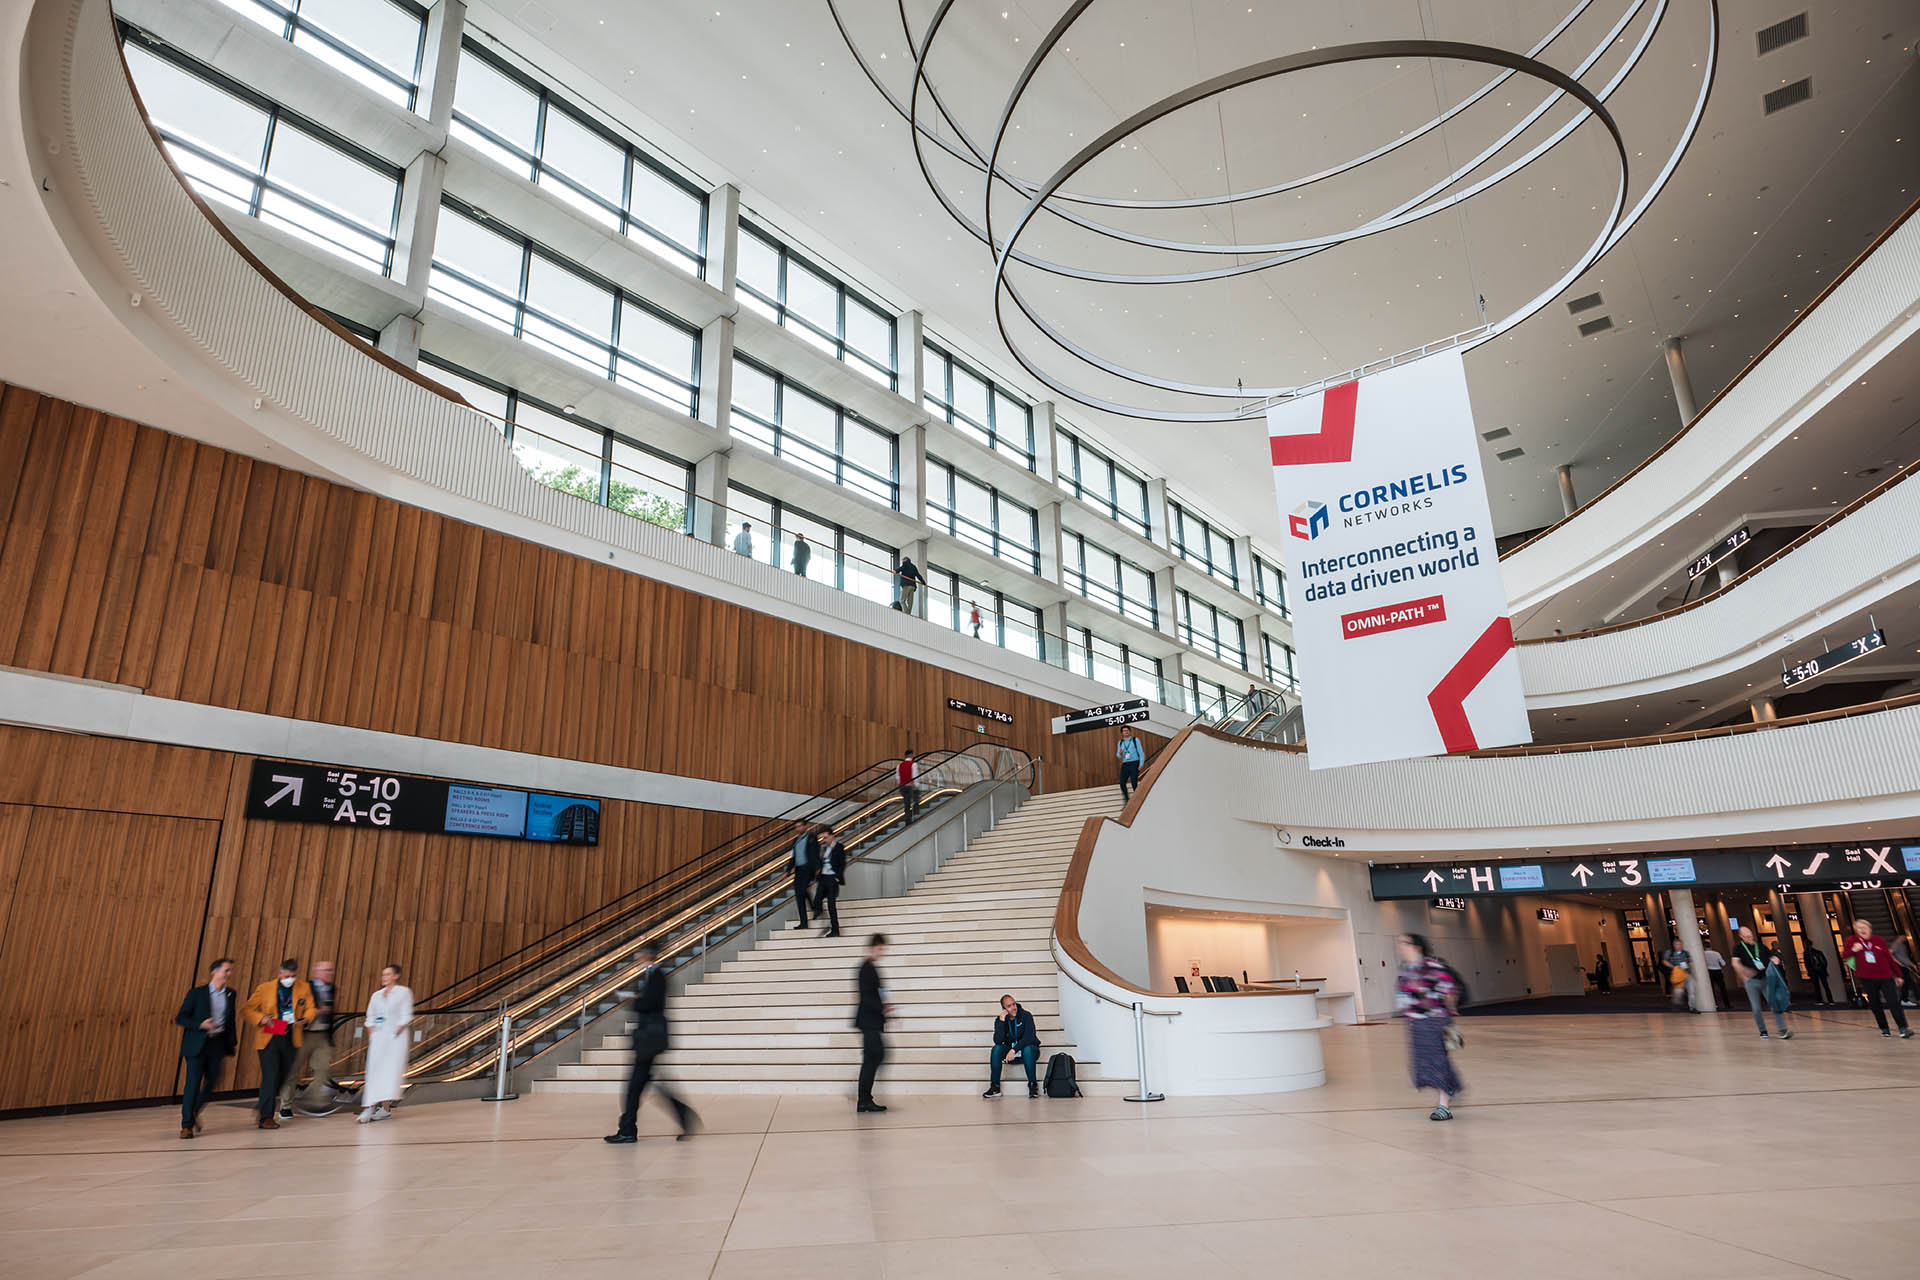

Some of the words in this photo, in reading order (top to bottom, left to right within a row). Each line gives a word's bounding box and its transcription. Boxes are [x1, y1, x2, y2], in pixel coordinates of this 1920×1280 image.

[1339, 464, 1467, 512] CORNELIS
[1343, 497, 1433, 528] NETWORKS
[1302, 530, 1459, 578] Interconnecting
[1463, 526, 1476, 541] a
[1305, 579, 1346, 601] data
[1351, 564, 1414, 592] driven
[1418, 547, 1479, 577] world
[1347, 605, 1425, 632] OMNI-PATH
[1796, 659, 1819, 680] 5-10
[1857, 637, 1869, 653] X
[1087, 707, 1102, 717] A-G
[1119, 703, 1125, 711] Z
[1108, 715, 1125, 725] 5-10
[1131, 713, 1138, 721] X
[338, 773, 400, 801] 5-10
[333, 799, 392, 826] A-G
[1618, 860, 1642, 886] 3
[1863, 846, 1898, 874] X
[1470, 866, 1495, 891] H
